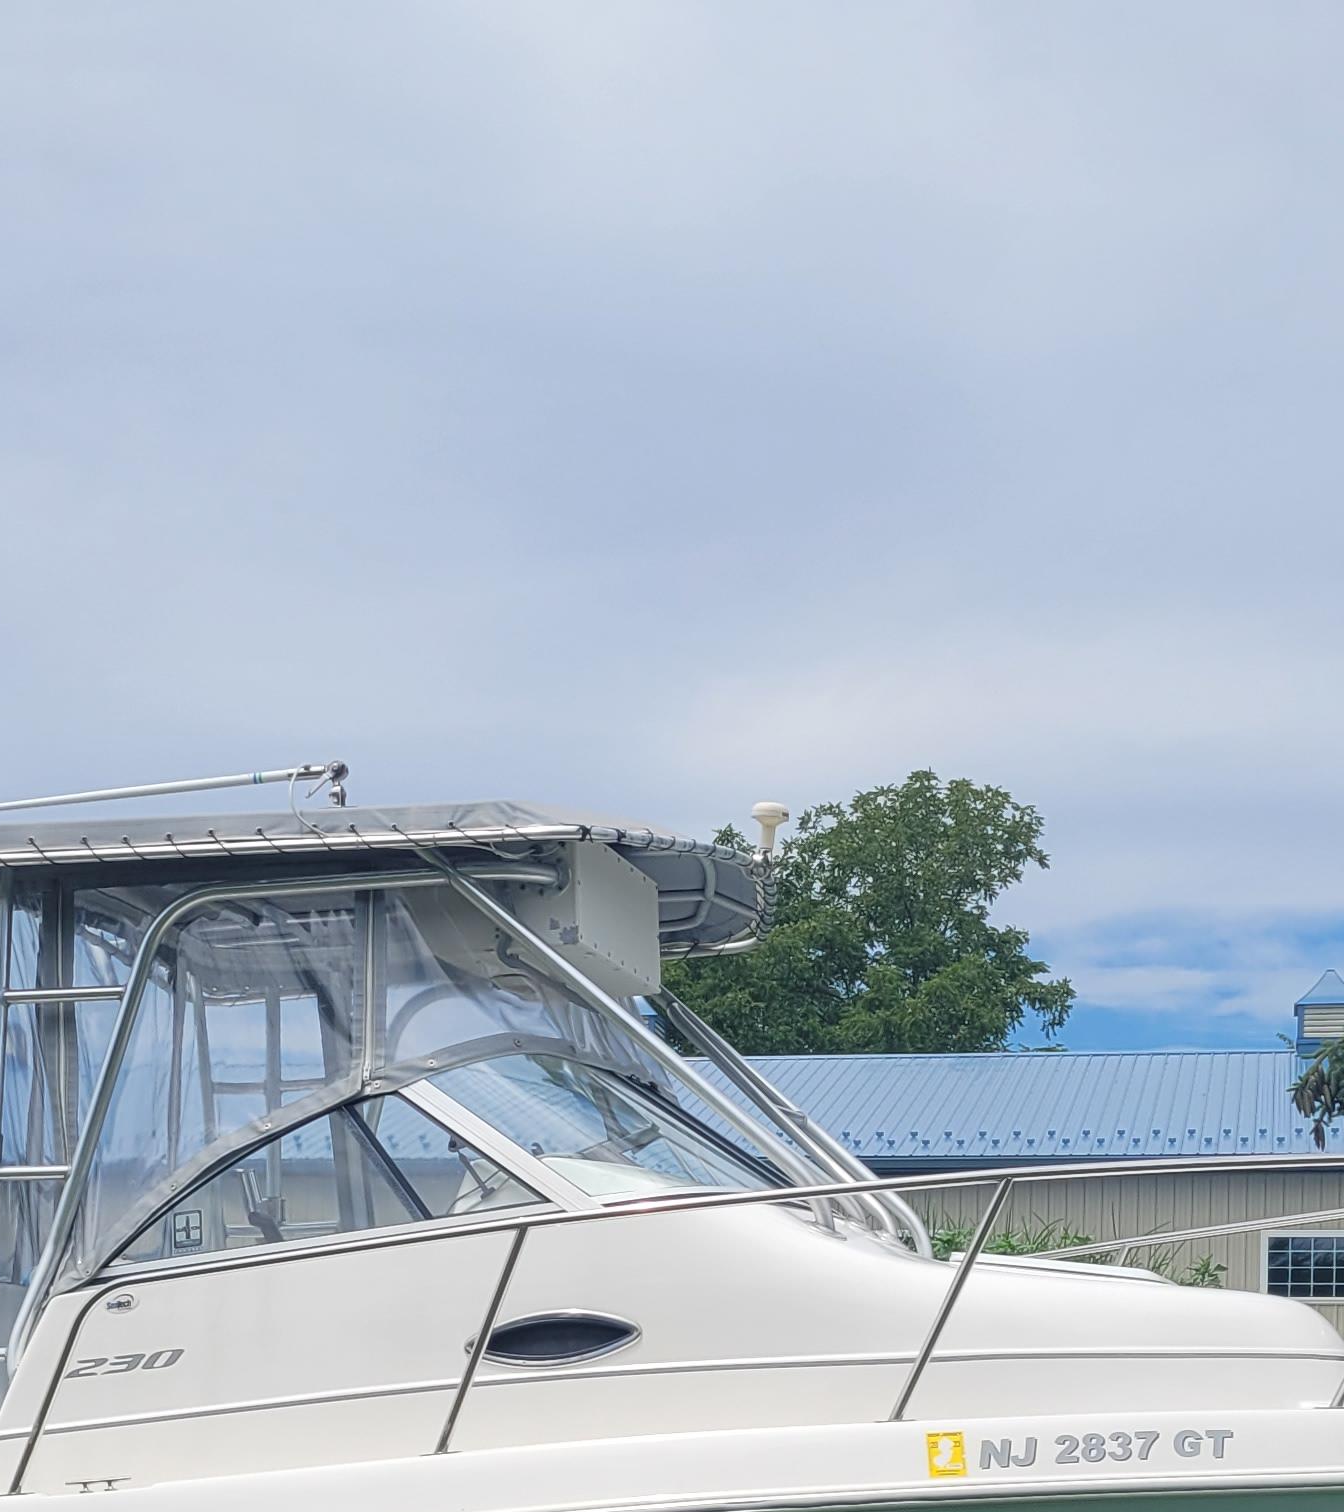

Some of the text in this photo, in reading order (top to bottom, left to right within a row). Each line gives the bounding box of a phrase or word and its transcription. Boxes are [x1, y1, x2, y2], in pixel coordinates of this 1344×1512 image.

[64, 1349, 185, 1379] 230
[979, 1429, 1234, 1470] NJ 2837 GT
